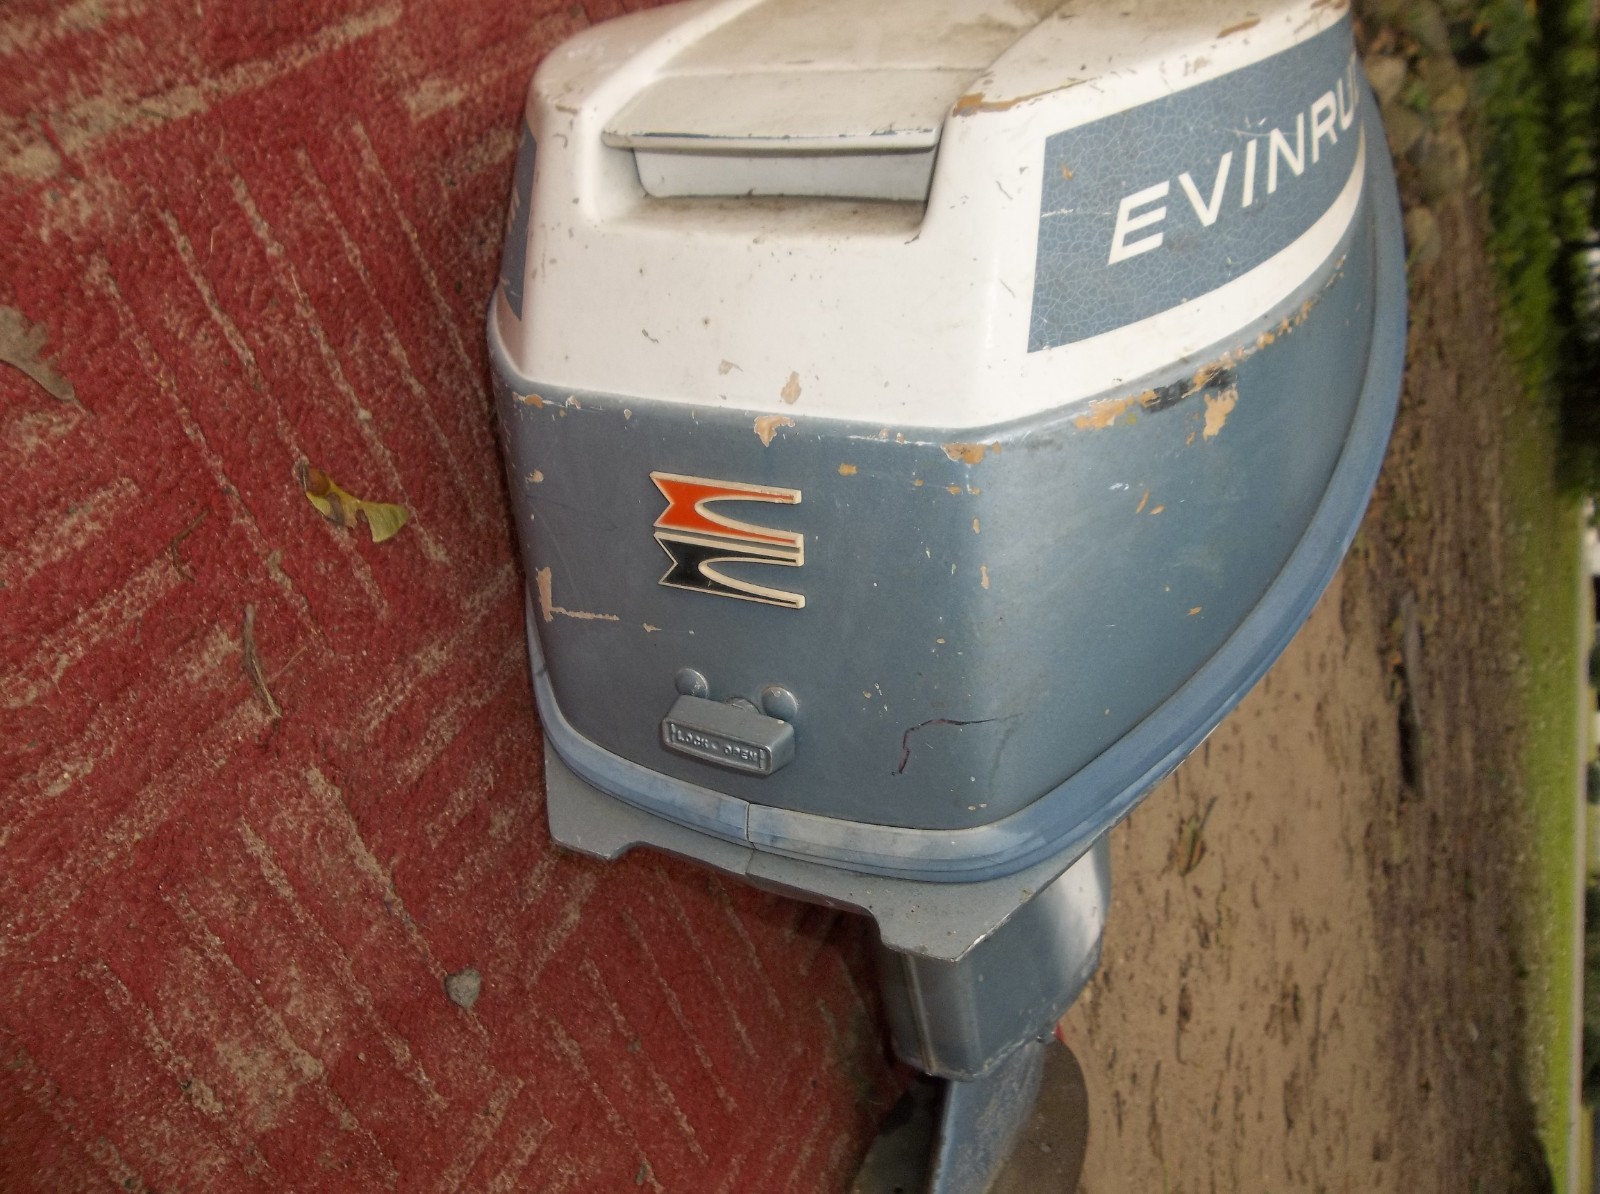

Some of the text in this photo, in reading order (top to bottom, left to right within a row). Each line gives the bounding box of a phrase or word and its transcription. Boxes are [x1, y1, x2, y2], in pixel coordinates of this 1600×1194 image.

[1107, 50, 1360, 266] EVINRU
[677, 729, 758, 762] LOCK OPEN
